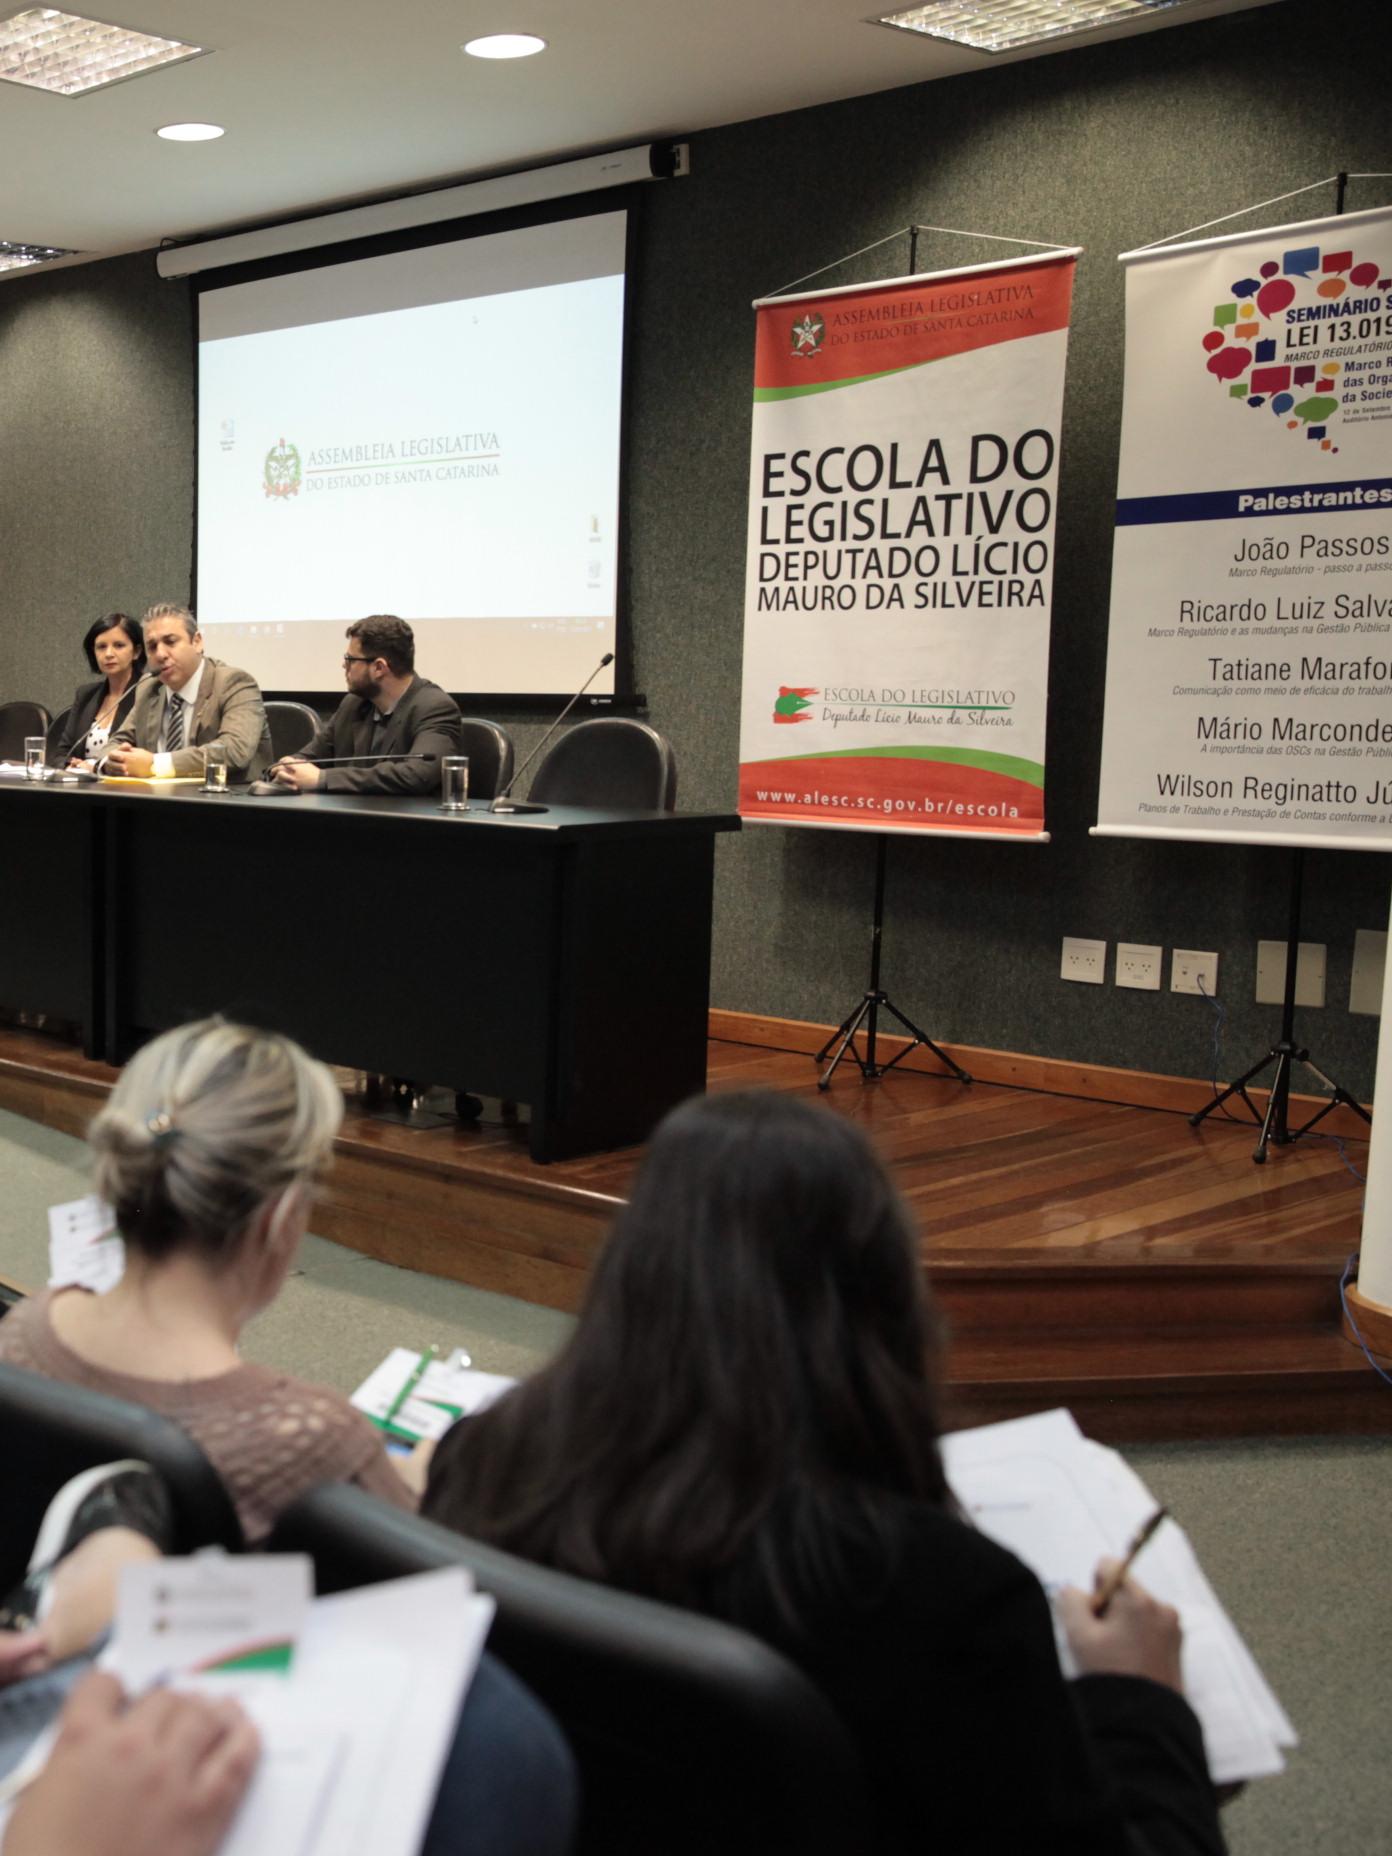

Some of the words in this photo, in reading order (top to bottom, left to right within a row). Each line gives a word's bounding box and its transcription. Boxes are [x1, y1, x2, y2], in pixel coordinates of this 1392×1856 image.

[832, 301, 924, 327] ASSEMBLEIA
[931, 285, 1034, 313] LEGISLATIVA
[1285, 297, 1381, 324] SEMINÁRIO
[831, 333, 850, 345] DO
[854, 327, 900, 343] ESTADO
[903, 324, 919, 336] DE
[923, 318, 963, 333] SANTA
[967, 308, 1034, 327] CATARINA
[1286, 325, 1318, 348] LEI
[1327, 316, 1392, 343] 13.019
[1284, 350, 1320, 363] MARCO
[1344, 360, 1382, 372] Marco
[1343, 377, 1364, 388] das
[1342, 392, 1356, 403] da
[308, 443, 396, 467] ASSEMBLEIA
[401, 432, 500, 457] LEGISLATIVA
[762, 438, 951, 499] ESCOLA
[969, 429, 1054, 484] DO
[306, 478, 324, 492] DO
[327, 473, 371, 490] ESTADO
[375, 472, 390, 486] DE
[393, 469, 432, 484] SANTA
[435, 463, 500, 481] CATARINA
[1238, 487, 1392, 512] Palestrantes
[760, 487, 1051, 545] LEGISLATIVO
[759, 545, 941, 582] DEPUTADO
[951, 535, 1048, 577] LÍCIO
[1234, 536, 1289, 562] João
[1300, 534, 1390, 559] Passos
[1228, 567, 1257, 578] Marco
[1260, 564, 1314, 578] Regulatório
[1323, 563, 1353, 575] passo
[1356, 564, 1362, 572] a
[757, 584, 856, 611] MAURO
[865, 583, 905, 609] DA
[914, 579, 1045, 609] SILVEIRA
[1179, 598, 1266, 623] Ricardo
[1276, 596, 1325, 621] Luiz
[1147, 627, 1175, 638] Marco
[1177, 625, 1228, 639] Regulatório
[1230, 628, 1236, 636] e
[1238, 628, 1250, 636] as
[1252, 625, 1299, 637] mudanças
[1301, 627, 1313, 635] na
[1316, 623, 1351, 635] Gestão
[1353, 621, 1390, 633] Pública
[1208, 657, 1291, 681] Tatiane
[824, 688, 876, 702] ESCOLA
[881, 689, 906, 703] DO
[911, 690, 1016, 705] LEGISLATIVO
[1172, 685, 1233, 697] Comunicação
[1235, 687, 1261, 696] como
[1263, 686, 1287, 695] meio
[1289, 686, 1301, 696] de
[1303, 685, 1339, 696] eficácia
[1342, 685, 1355, 696] do
[822, 707, 870, 729] Deputado
[874, 708, 901, 723] Lício
[905, 710, 943, 725] Mauro
[947, 710, 963, 725] da
[966, 709, 1014, 727] Silveira
[1197, 716, 1262, 740] Mário
[1200, 744, 1208, 753] A
[1209, 744, 1264, 756] importância
[1266, 745, 1283, 755] das
[1285, 745, 1311, 756] OSCs
[1314, 747, 1326, 756] na
[1328, 746, 1362, 757] Gestão
[1157, 774, 1233, 799] Wilson
[1243, 776, 1357, 806] Reginatto
[757, 791, 1019, 818] www.alesc.sc.gov.br/escola
[1138, 802, 1167, 814] Planos
[1169, 804, 1180, 815] de
[1183, 804, 1221, 816] Trabalho
[1223, 808, 1229, 816] e
[1231, 807, 1276, 820] Prestação
[1279, 809, 1291, 819] de
[1293, 809, 1327, 821] Contas
[1329, 811, 1377, 823] conforme
[1379, 815, 1386, 823] a
